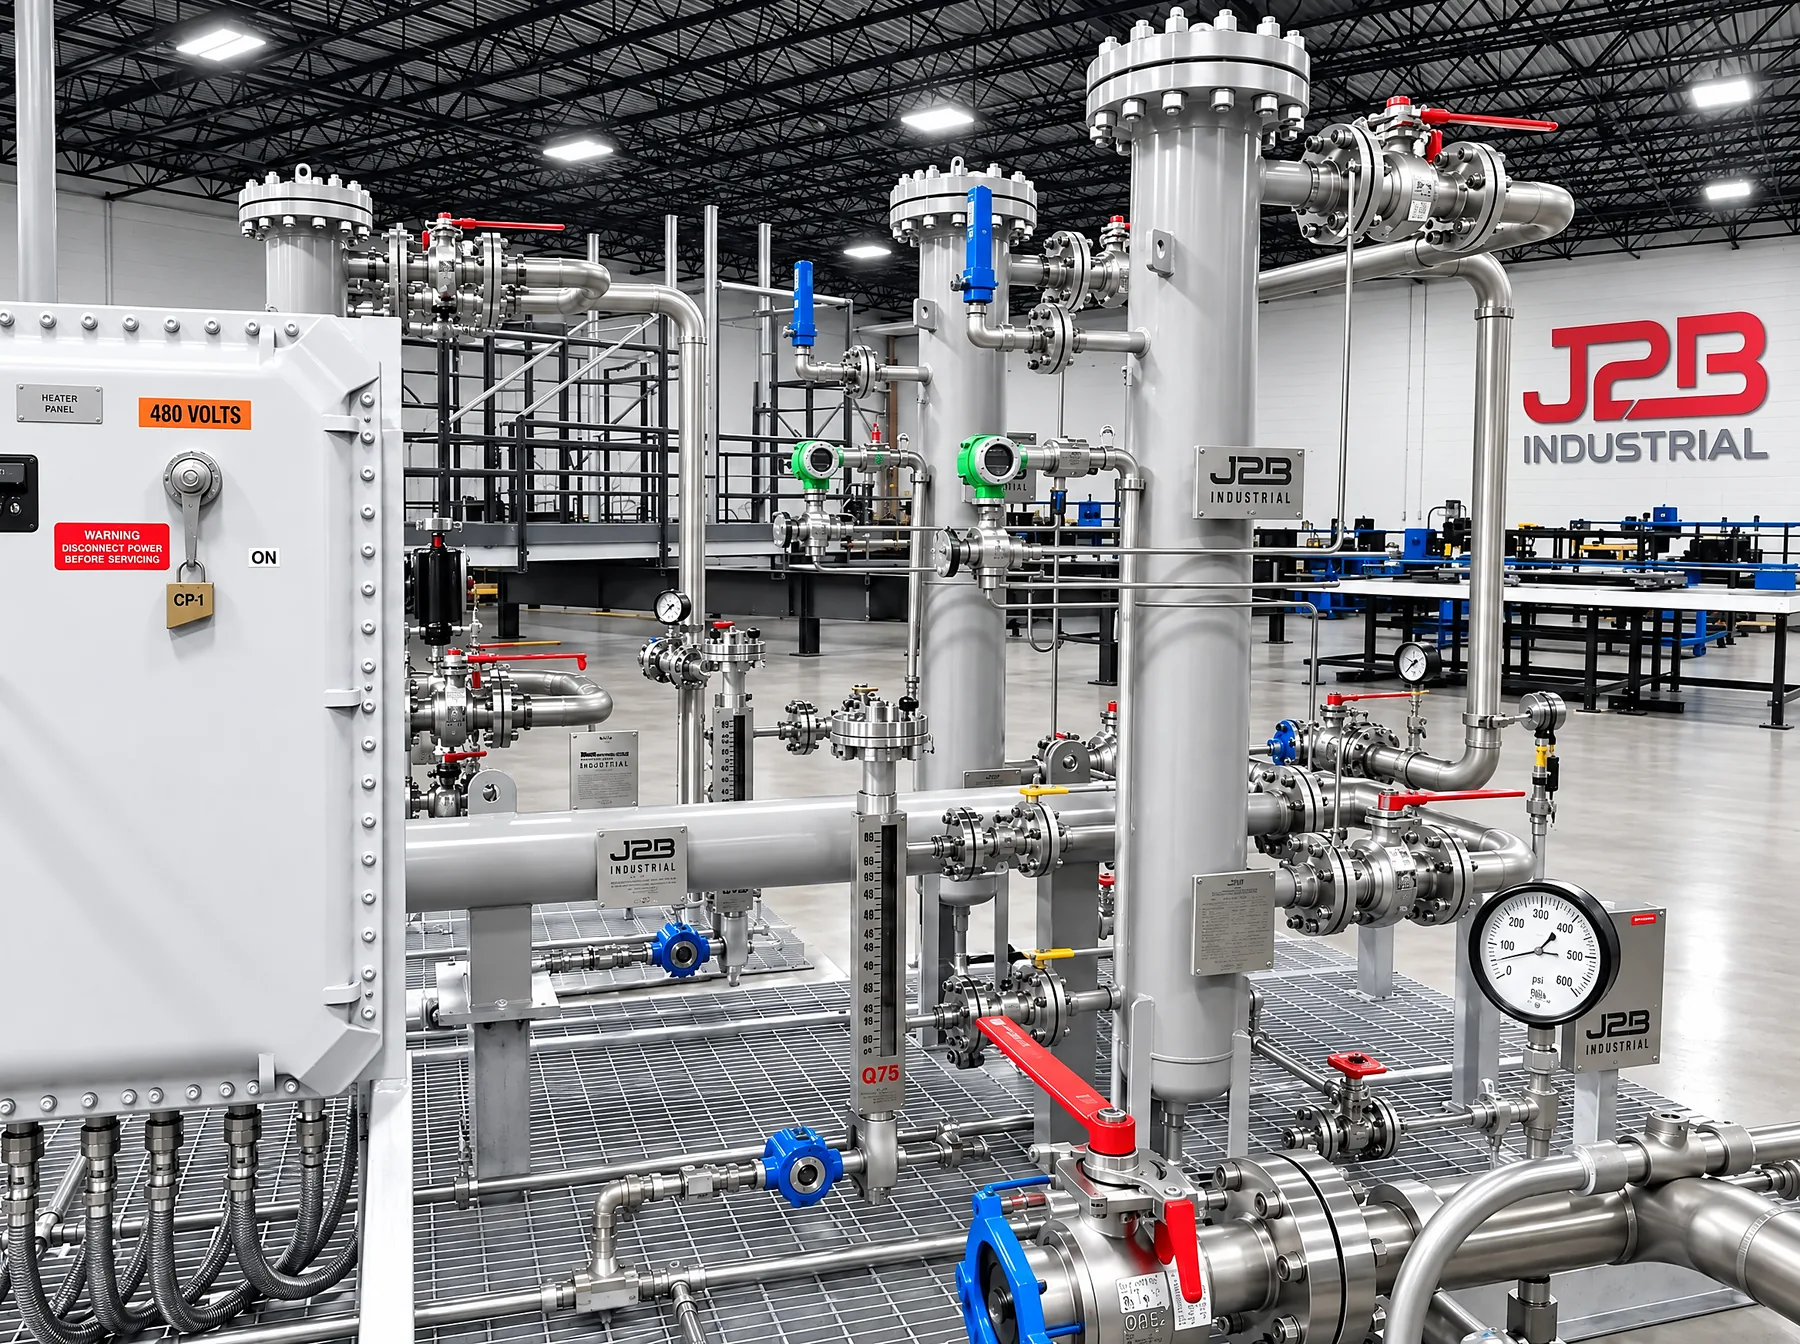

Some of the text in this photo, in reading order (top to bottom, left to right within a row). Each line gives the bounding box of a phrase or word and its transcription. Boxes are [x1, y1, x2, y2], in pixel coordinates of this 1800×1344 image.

[1523, 311, 1768, 425] J2B
[41, 394, 78, 403] HEATER
[45, 405, 75, 414] PANEL
[150, 404, 241, 424] 480 VOLTS
[1523, 427, 1769, 464] INDUSTRIAL
[1210, 456, 1292, 485] J2B
[1210, 491, 1291, 504] INDUSTRIAL
[84, 530, 141, 541] WARNING
[62, 544, 163, 553] DISCONNECT POWER
[64, 555, 160, 564] BEFORE SERVICING
[251, 550, 277, 564] ON
[173, 593, 204, 607] CP-1
[610, 838, 676, 861] J2B
[610, 862, 676, 875] INDUSTRIAL
[1532, 908, 1549, 920] 300
[1508, 916, 1525, 929] 200
[1556, 922, 1574, 935] 400
[1500, 940, 1515, 951] 100
[1566, 950, 1583, 962] 500
[1506, 965, 1512, 976] 0
[1532, 976, 1544, 985] psi
[1556, 975, 1573, 987] 600
[1586, 1009, 1650, 1039] J2B
[1586, 1037, 1649, 1056] INDUSTRIAL
[861, 1064, 900, 1084] Q75
